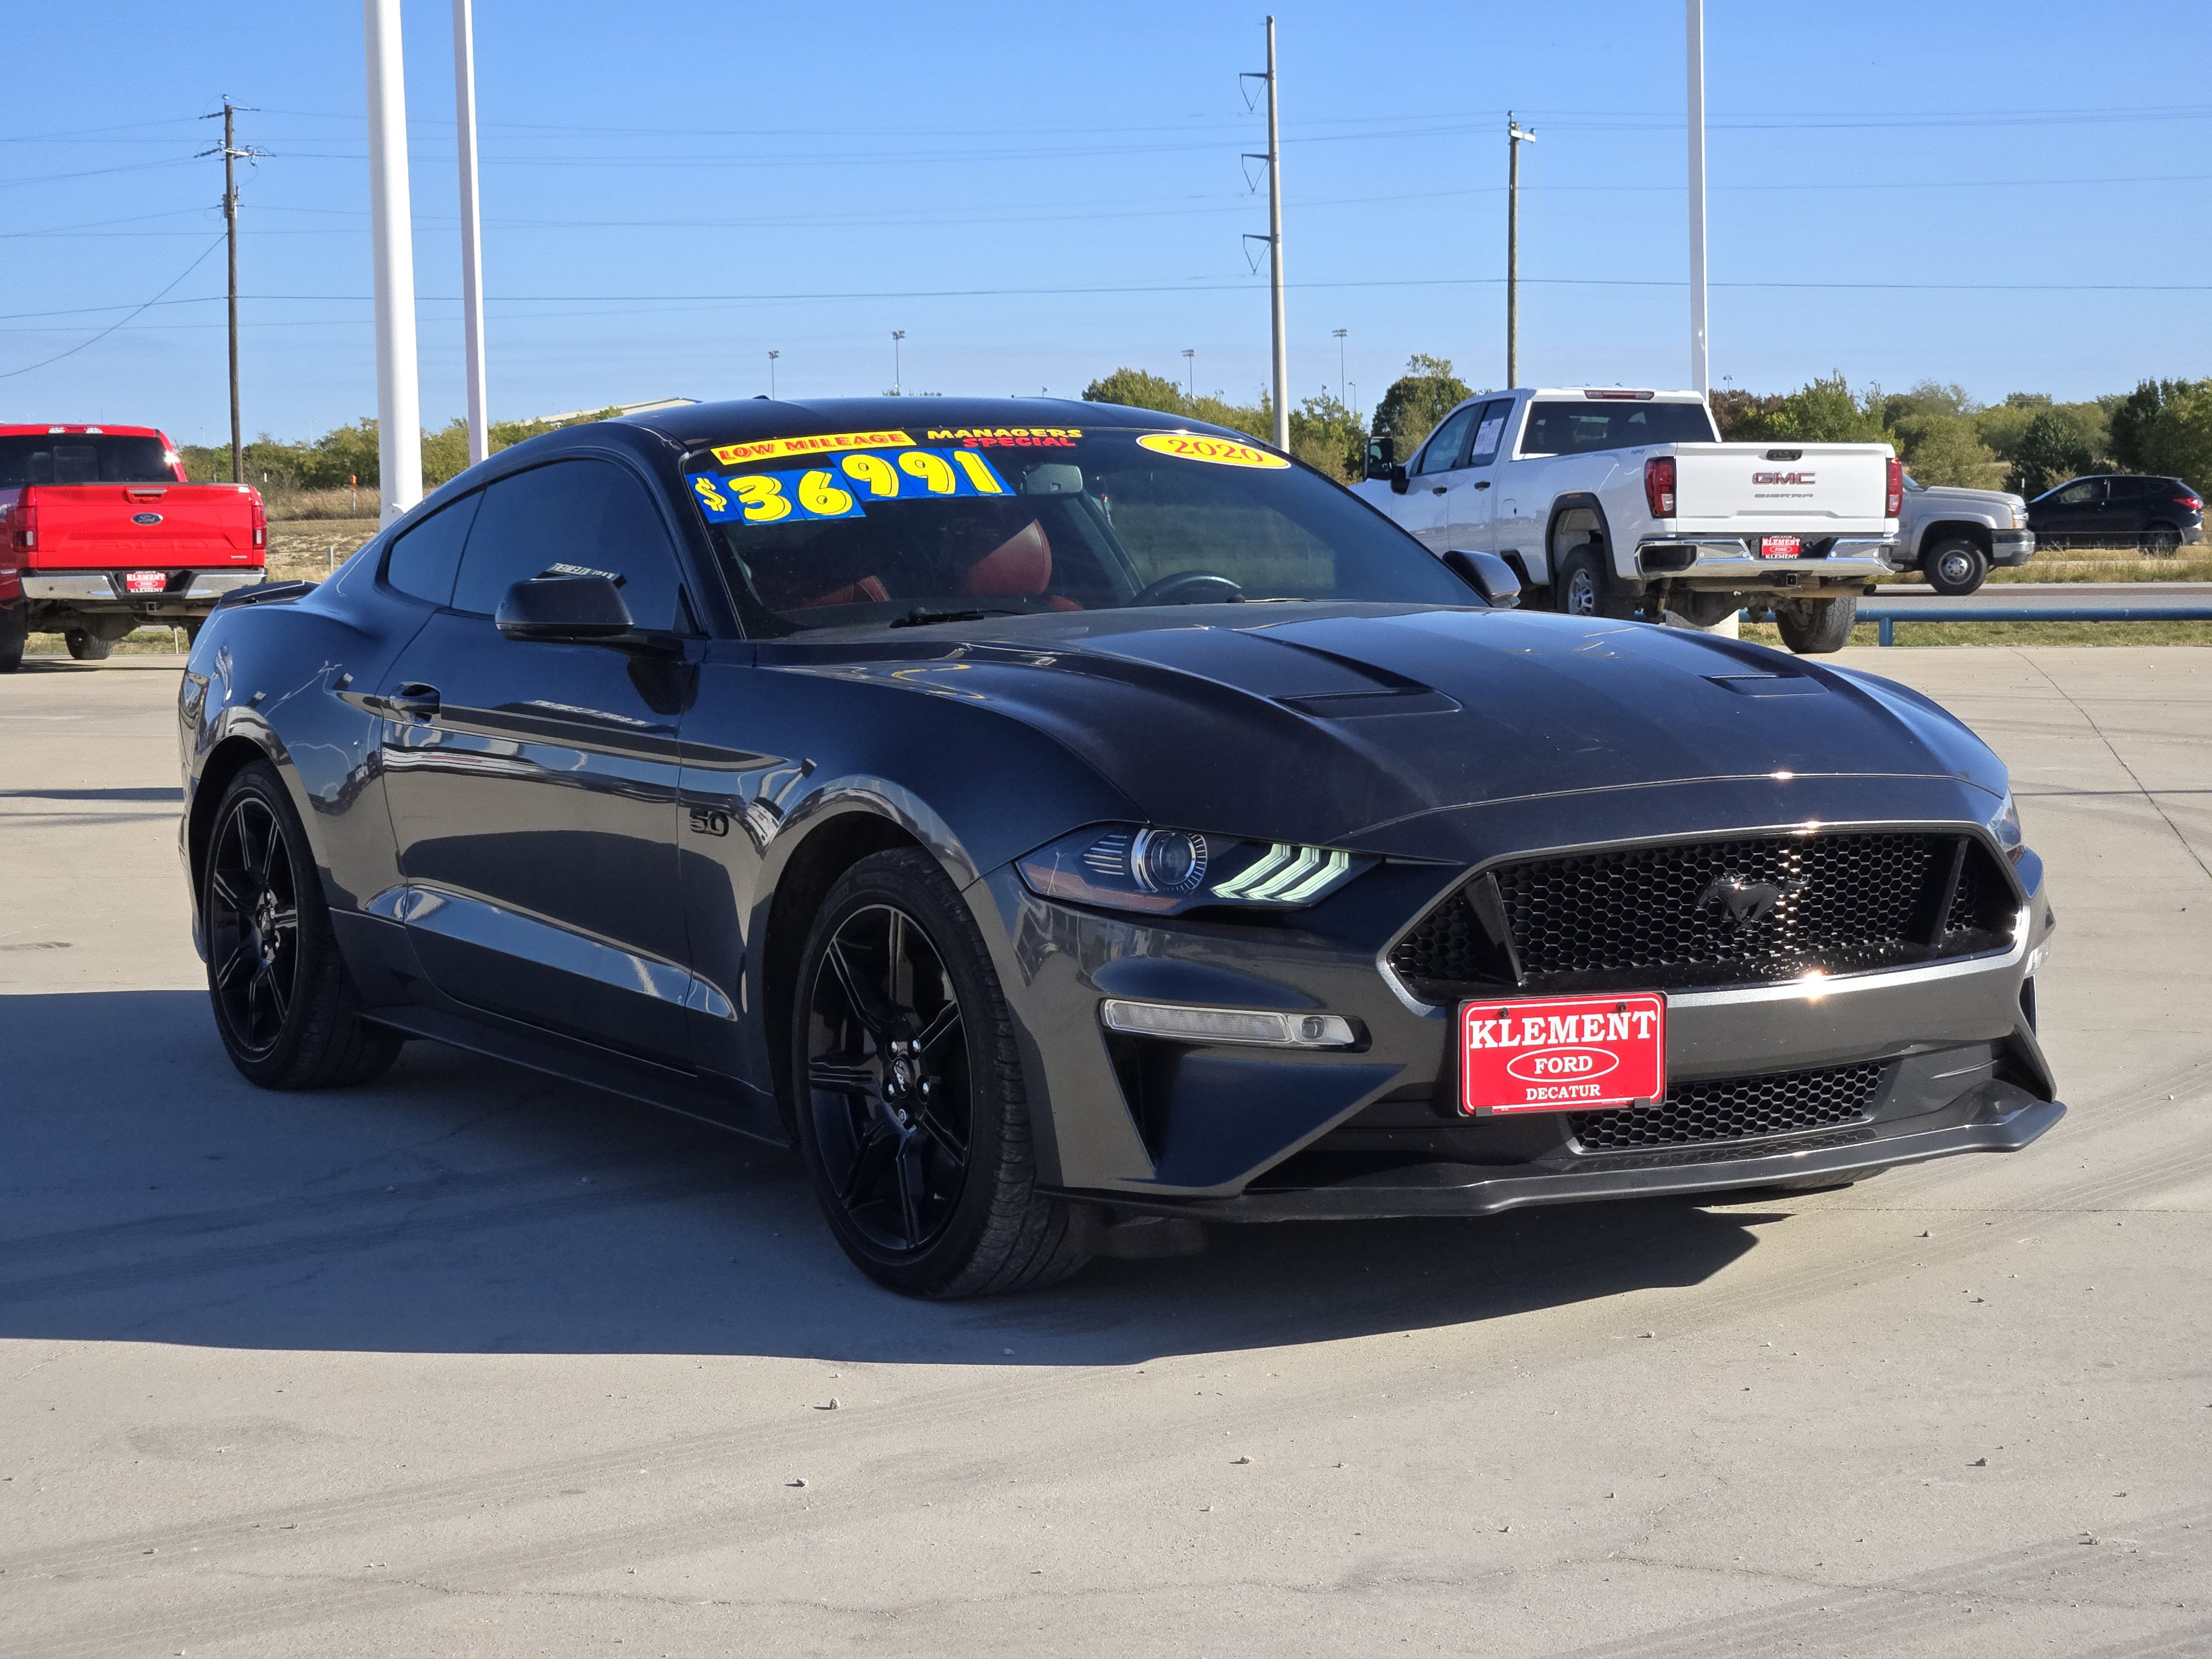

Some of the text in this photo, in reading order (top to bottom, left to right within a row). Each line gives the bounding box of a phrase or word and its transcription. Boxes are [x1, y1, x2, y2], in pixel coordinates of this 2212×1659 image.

[927, 429, 1082, 440] MANAGERS
[963, 437, 1076, 447] SPECIAL
[718, 434, 907, 460] LOW MILEAGE
[1168, 439, 1264, 462] 2020
[1752, 472, 1815, 484] GMC
[1470, 1010, 1656, 1049] KLEMENT
[1535, 1056, 1593, 1074] FORD
[1526, 1084, 1601, 1100] DECATUR
